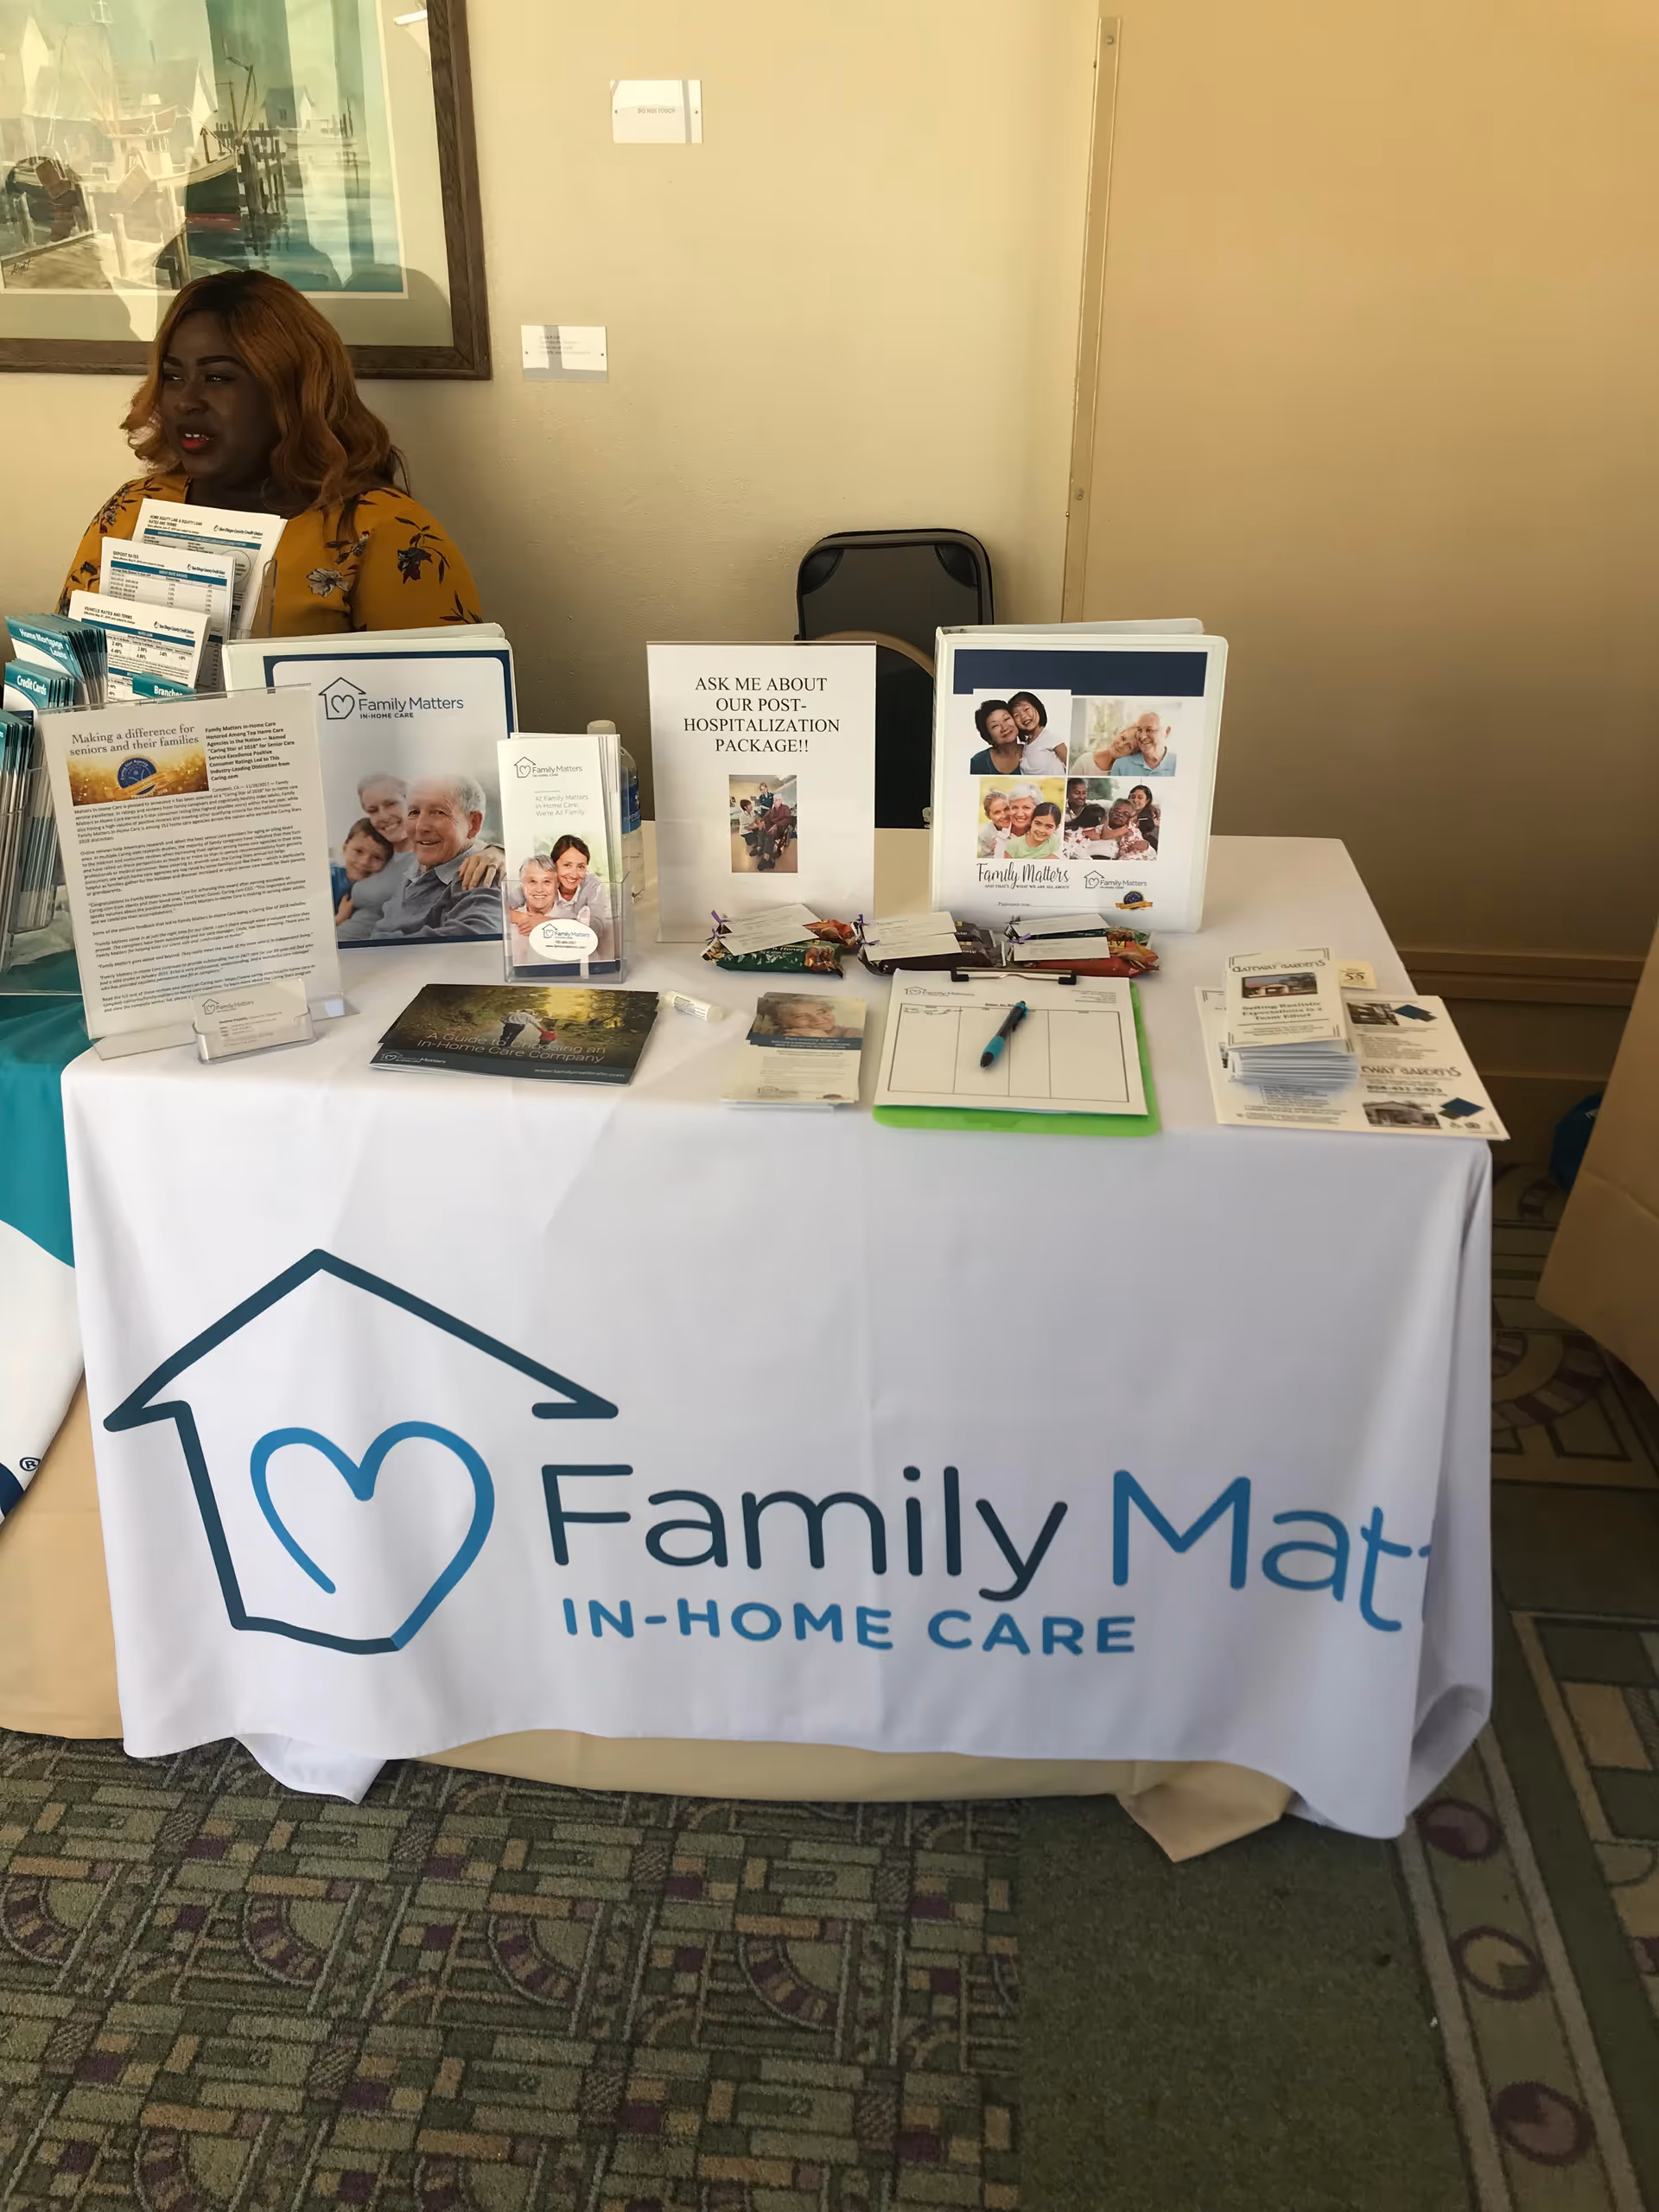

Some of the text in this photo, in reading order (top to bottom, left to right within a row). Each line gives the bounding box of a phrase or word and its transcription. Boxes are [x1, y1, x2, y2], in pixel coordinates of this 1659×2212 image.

[19, 627, 63, 649] Home Mortgage
[50, 647, 67, 659] Loans
[16, 675, 47, 695] Credit Cards
[695, 677, 827, 691] ASK ME ABOUT
[359, 697, 464, 712] Family Matters
[716, 698, 806, 711] OUR POST-
[72, 733, 114, 744] Making
[125, 727, 176, 739] difference
[180, 724, 194, 734] for
[683, 718, 840, 732] HOSPITALIZATION
[70, 734, 199, 755] seniors and their families
[715, 739, 808, 752] PACKAGE!!
[210, 766, 251, 774] Industry-Leading
[976, 861, 1070, 889] Family Matters
[417, 1040, 605, 1064] In-Home Care Company
[442, 1033, 487, 1043] Guide
[511, 1039, 582, 1053] Choosing
[541, 1465, 1431, 1632] Family Mat
[563, 1598, 1136, 1656] IN-HOME CARE
